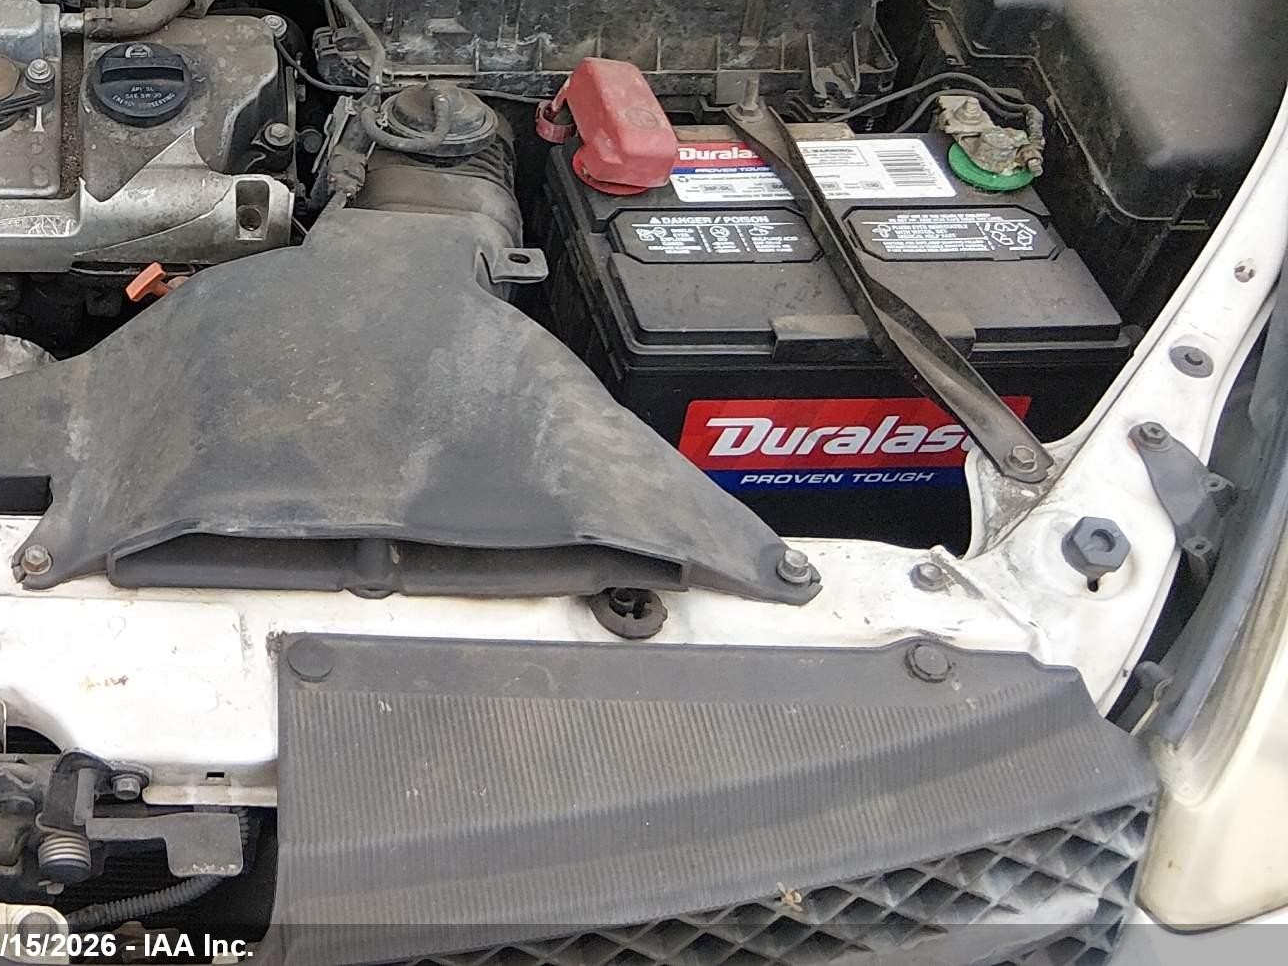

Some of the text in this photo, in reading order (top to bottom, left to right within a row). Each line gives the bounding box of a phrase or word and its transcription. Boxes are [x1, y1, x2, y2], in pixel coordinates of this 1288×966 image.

[678, 147, 759, 161] Durala
[661, 216, 713, 224] DANGER
[722, 215, 770, 224] POISON
[740, 472, 936, 485] PROVEN TOUGH
